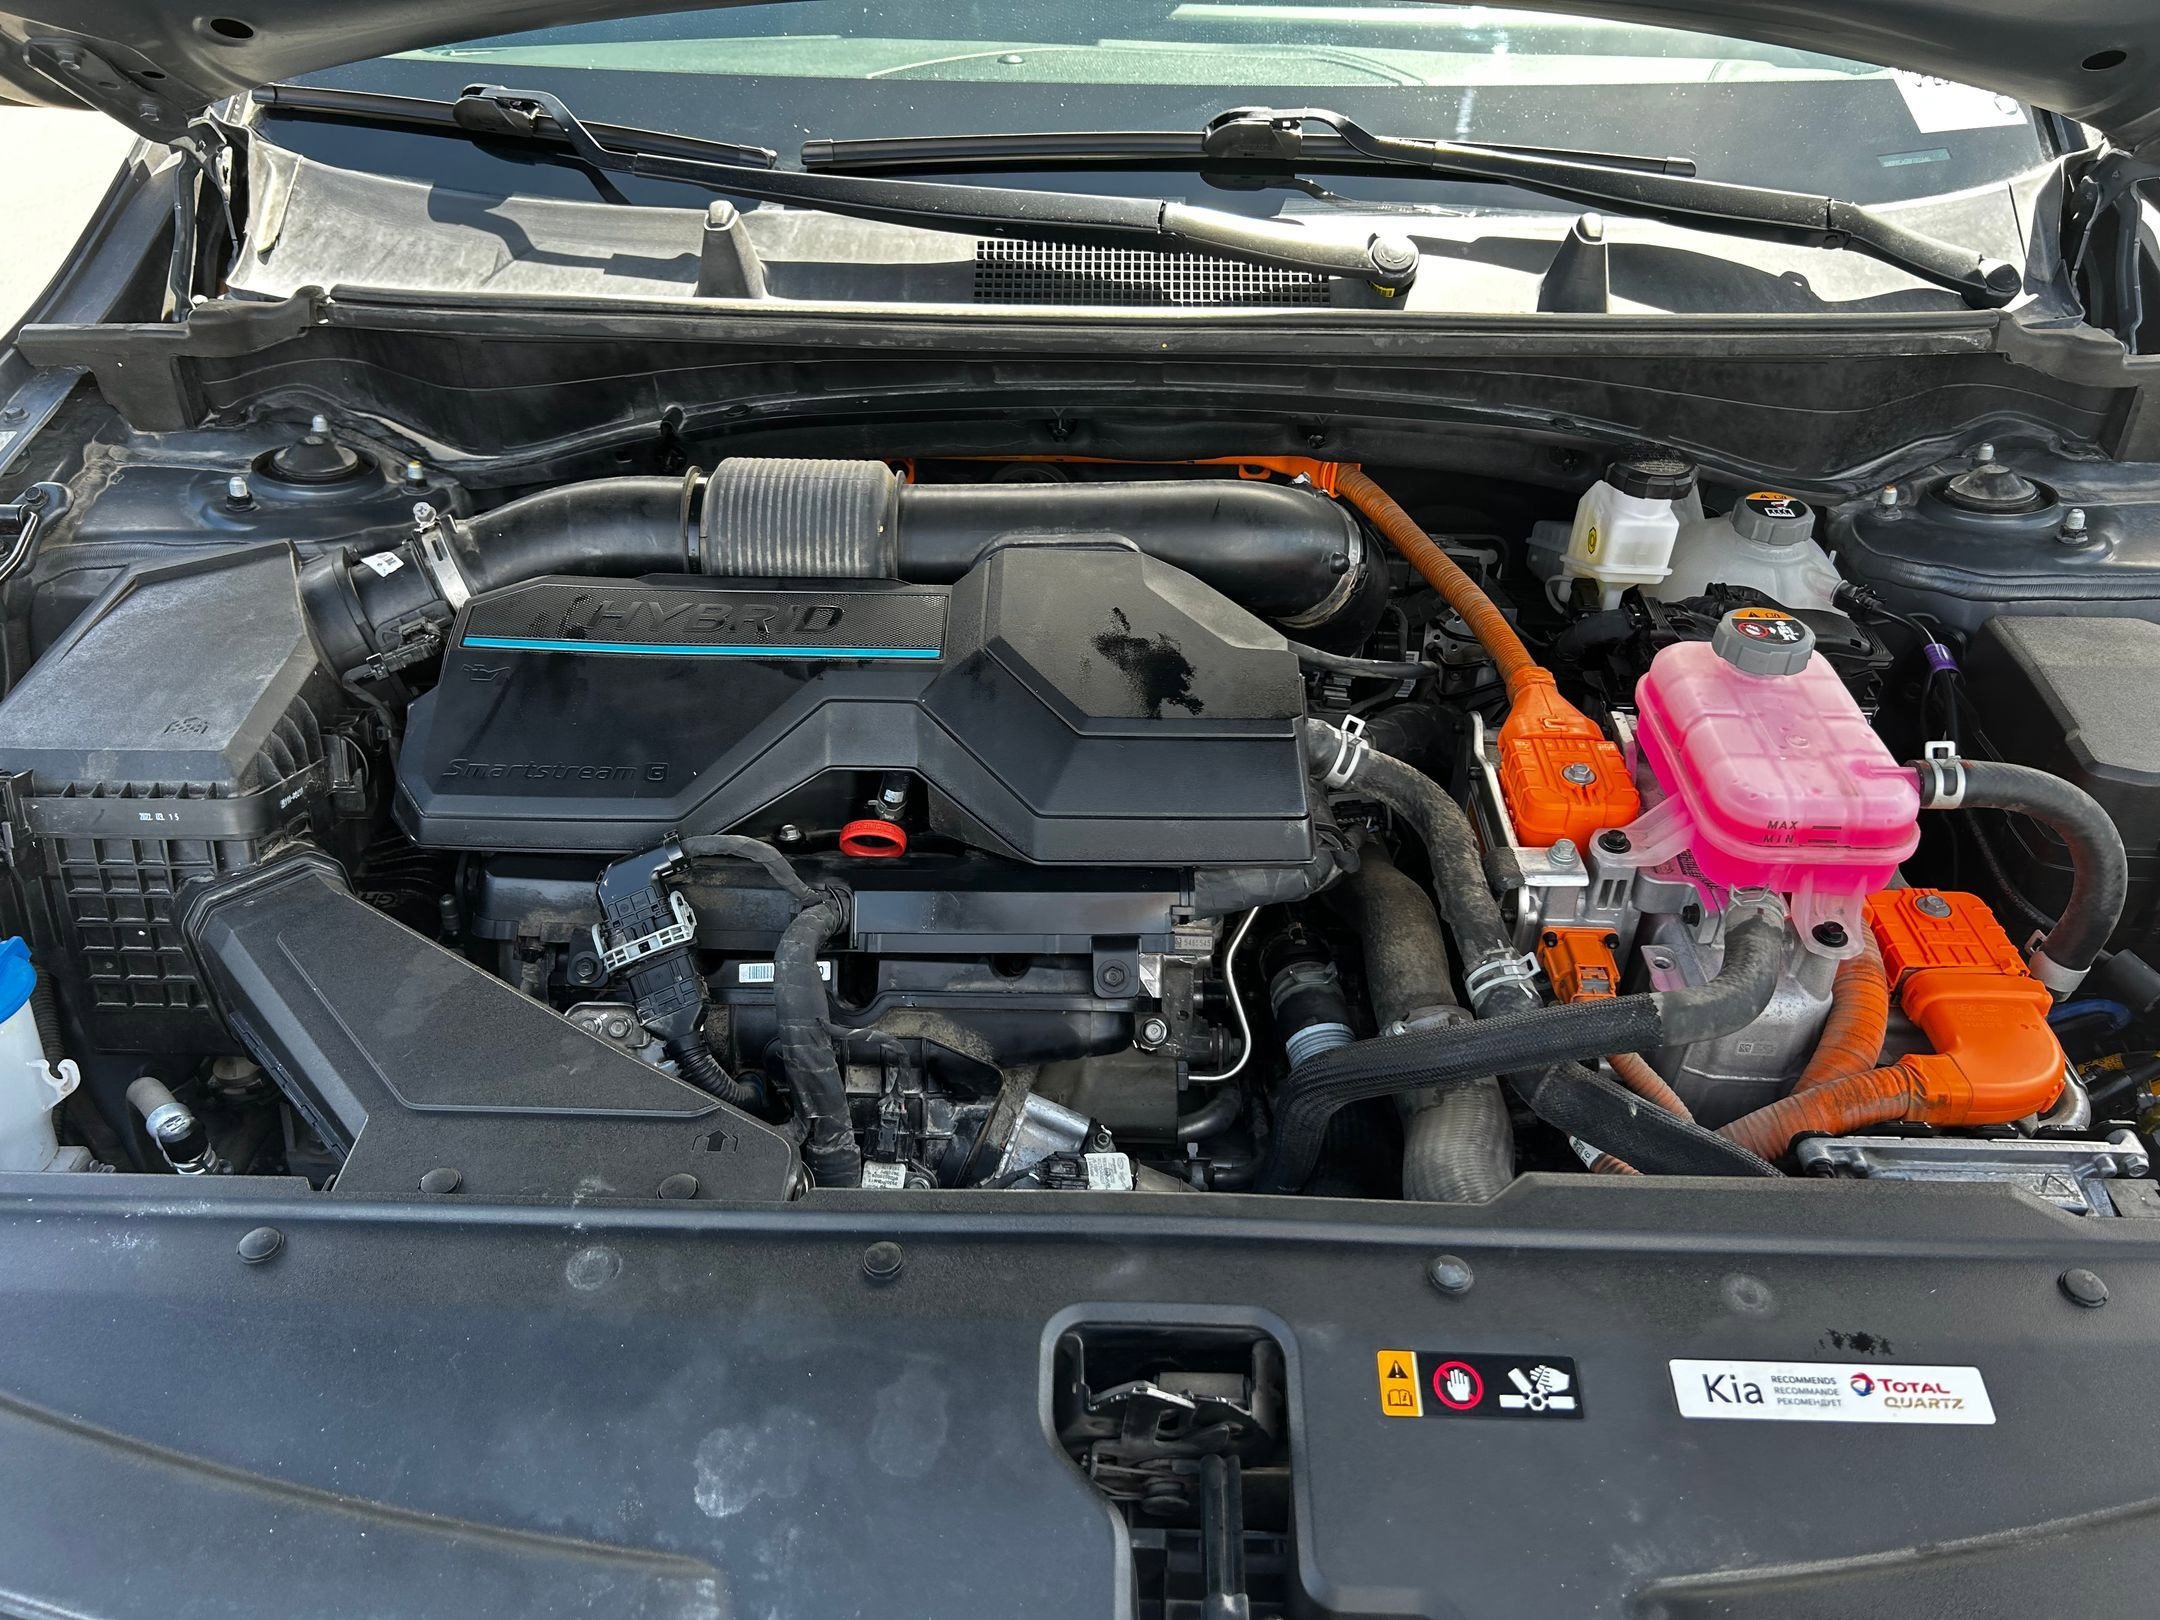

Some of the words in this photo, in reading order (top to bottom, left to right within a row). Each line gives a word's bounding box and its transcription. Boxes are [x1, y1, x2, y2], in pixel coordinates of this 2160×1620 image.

[586, 600, 845, 634] HYBRID
[442, 758, 637, 779] Smartstream
[1767, 820, 1799, 830] MAX
[1763, 834, 1794, 844] MIN
[1771, 1375, 1837, 1385] RECOMMENDS
[1877, 1378, 1951, 1394] TOTAL
[1701, 1373, 1764, 1405] Kia
[1774, 1386, 1840, 1396] RECOMMANDE
[1777, 1397, 1842, 1408] РЕКОМЕНДУЕТ
[1884, 1396, 1964, 1409] QUARTZ
